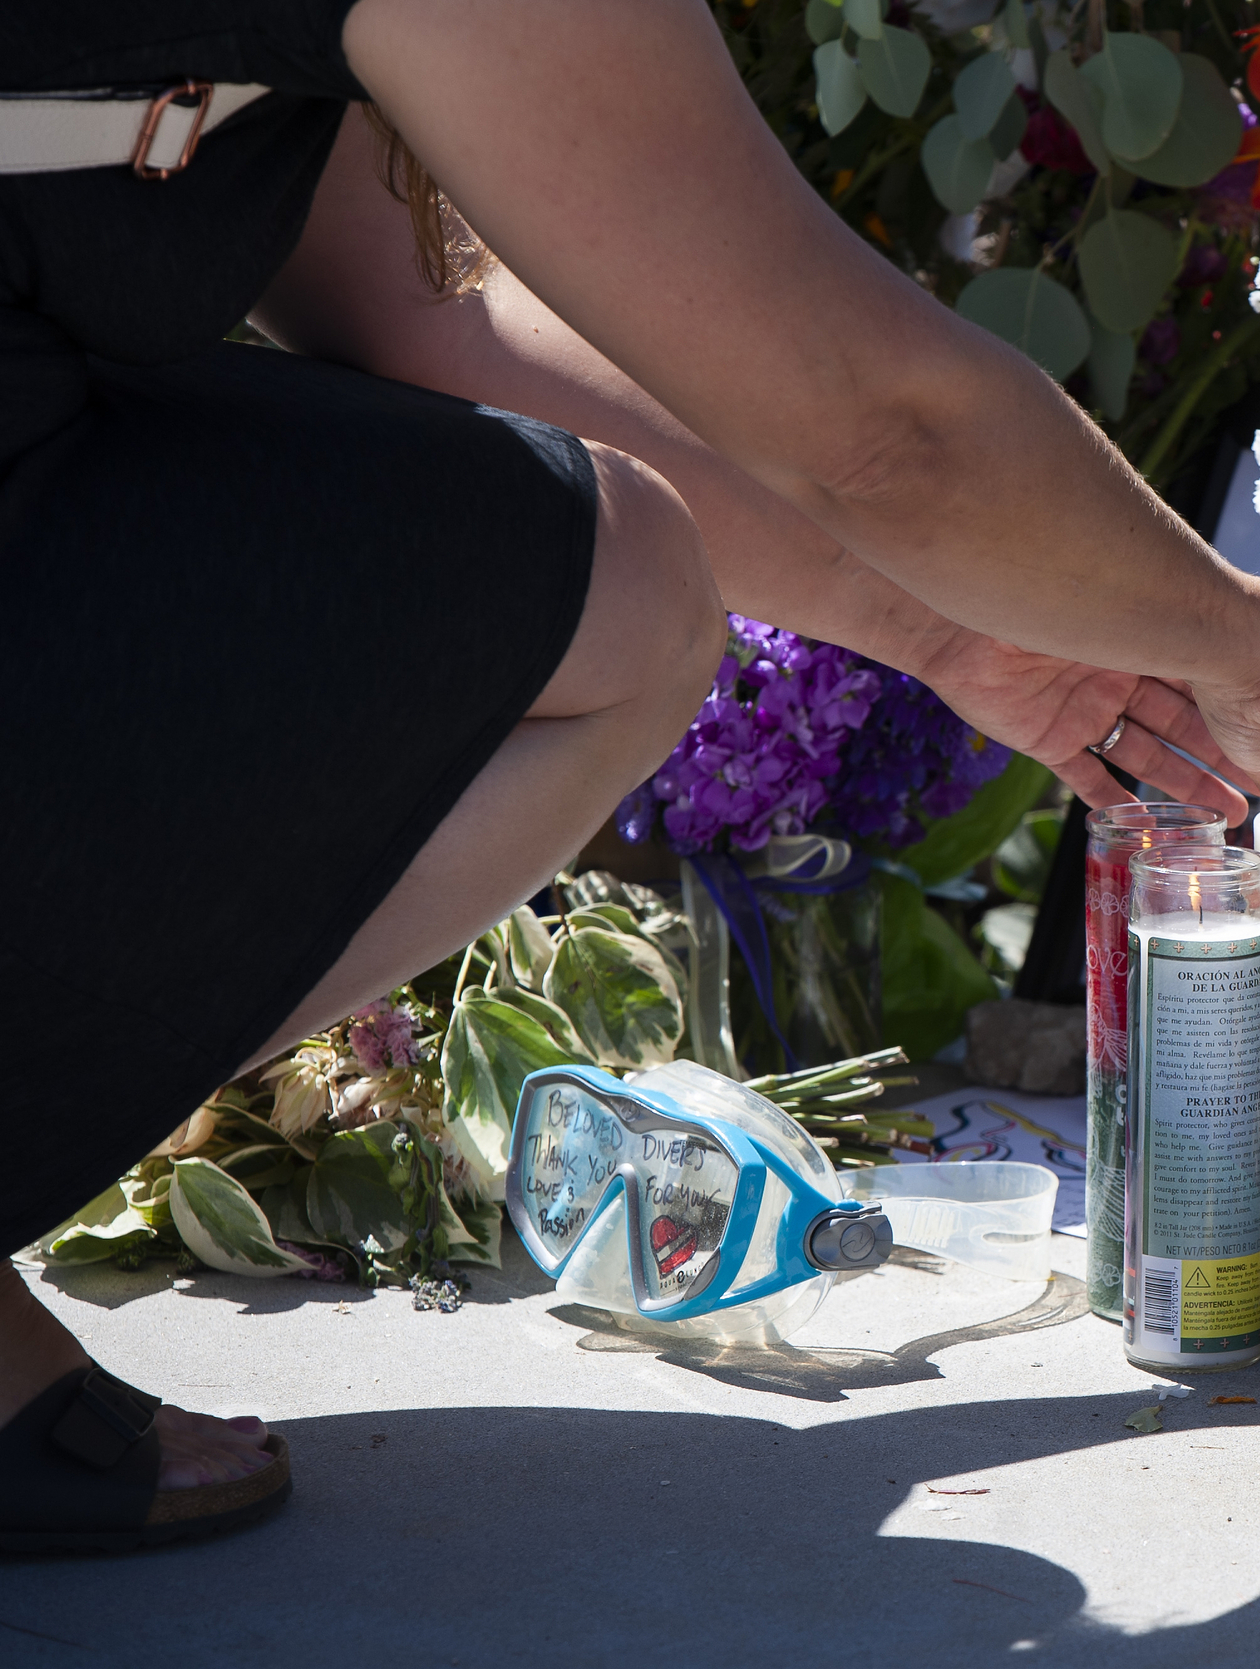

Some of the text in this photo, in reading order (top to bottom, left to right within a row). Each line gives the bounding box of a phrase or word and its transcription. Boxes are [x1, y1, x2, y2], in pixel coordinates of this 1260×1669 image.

[1178, 970, 1230, 980] ORACIÓN
[1233, 970, 1246, 979] AL
[1192, 984, 1207, 992] DE
[1211, 984, 1225, 992] LA
[1184, 1018, 1212, 1027] ayudan.
[1156, 1038, 1190, 1047] problemas
[1156, 1060, 1182, 1068] mañana
[1156, 1070, 1183, 1080] afligido,
[1199, 1074, 1212, 1082] que
[1186, 1097, 1230, 1106] PRAYER
[1234, 1094, 1247, 1104] TO
[1180, 1106, 1239, 1117] GUARDIAN
[547, 1089, 623, 1151] BELOVED
[1155, 1118, 1173, 1128] Spirit
[1176, 1121, 1210, 1130] protector,
[1154, 1141, 1168, 1149] who
[1171, 1143, 1186, 1152] help
[641, 1134, 707, 1172] DIVERS
[528, 1133, 617, 1186] THANK YOU
[1221, 1163, 1236, 1172] soul.
[1159, 1174, 1175, 1182] must
[1228, 1174, 1241, 1182] And
[526, 1176, 561, 1202] LOVE
[645, 1175, 674, 1206] FOR
[1153, 1185, 1179, 1195] courage
[1202, 1186, 1230, 1195] afflicted
[1154, 1195, 1168, 1203] lems
[1170, 1197, 1203, 1207] disappear
[538, 1207, 585, 1240] Passion
[1166, 1245, 1181, 1255] NET
[1183, 1246, 1220, 1256] WT/PESO
[1222, 1244, 1241, 1254] NETO
[1216, 1264, 1247, 1273] WARNING:
